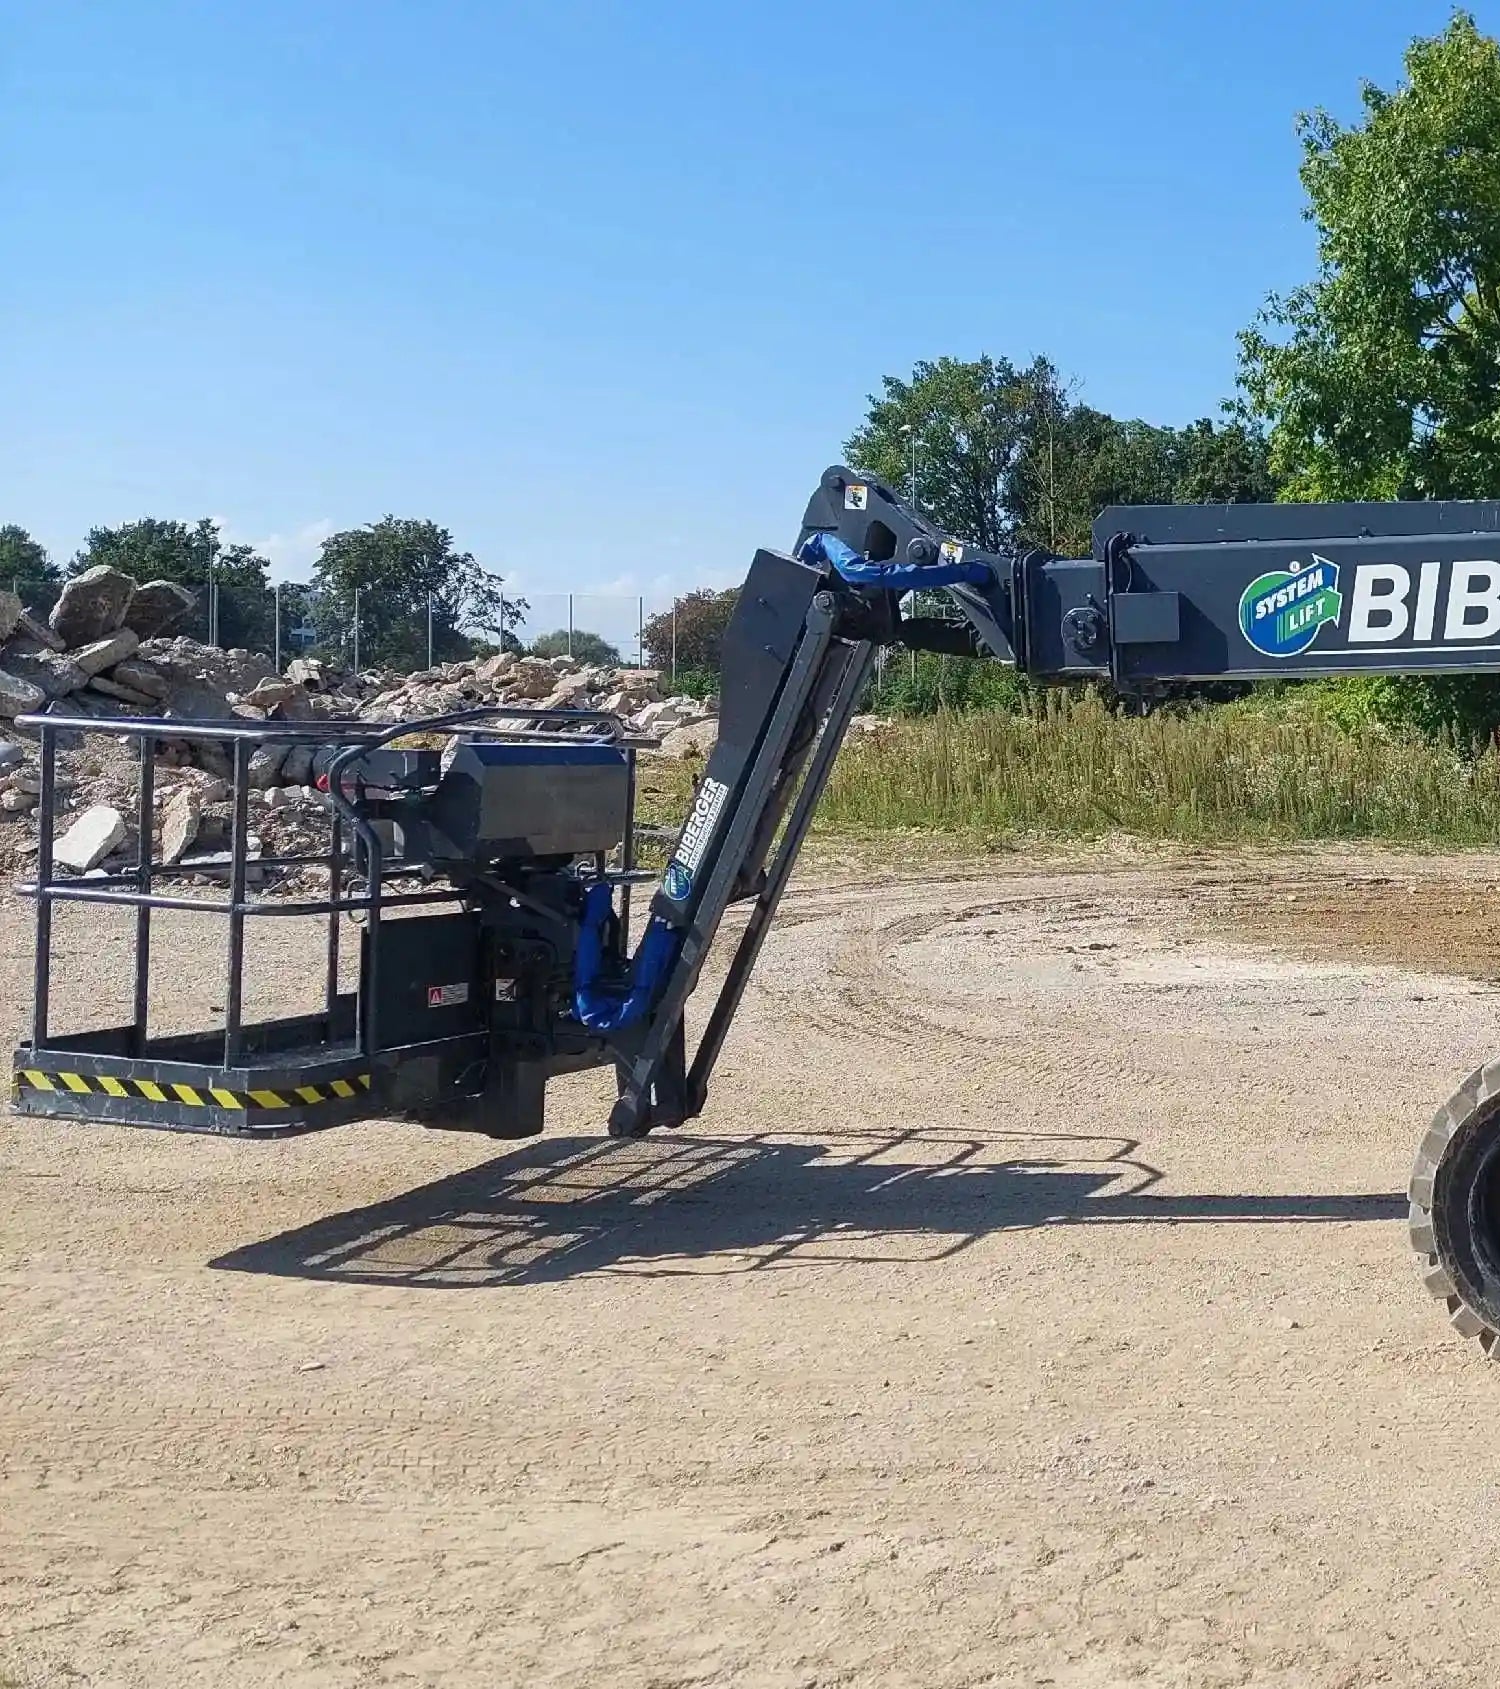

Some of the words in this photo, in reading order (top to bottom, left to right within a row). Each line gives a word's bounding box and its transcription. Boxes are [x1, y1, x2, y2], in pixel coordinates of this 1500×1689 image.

[1255, 568, 1324, 619] SYSTEM
[1288, 597, 1326, 631] LIFT
[674, 777, 721, 866] BIBERGER
